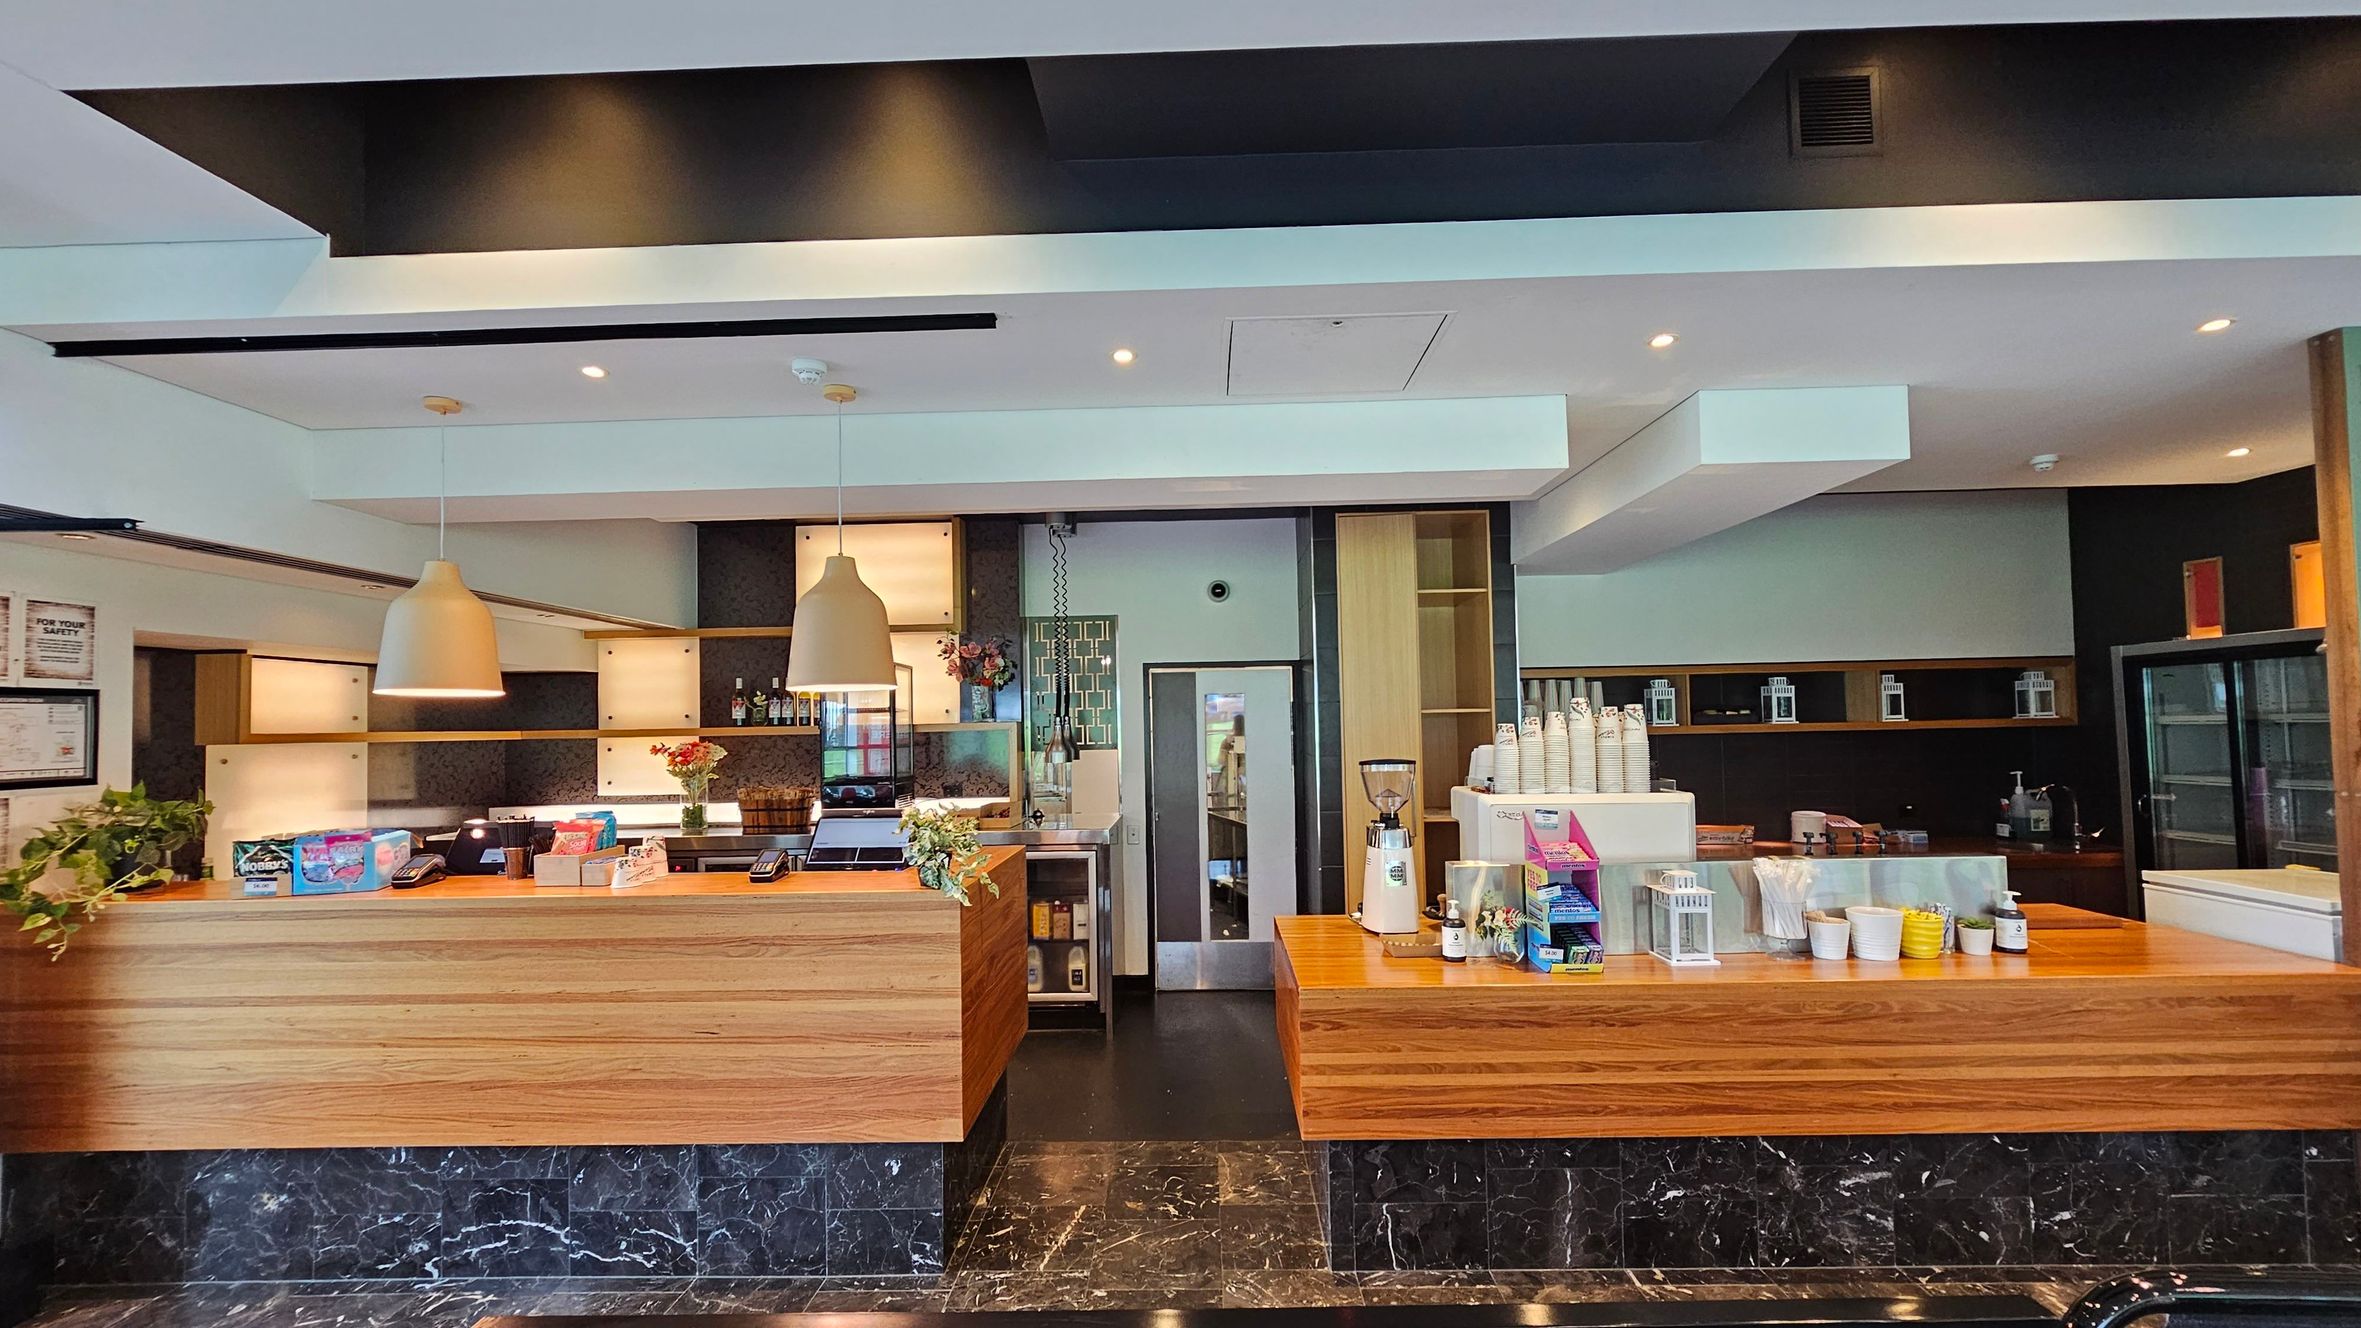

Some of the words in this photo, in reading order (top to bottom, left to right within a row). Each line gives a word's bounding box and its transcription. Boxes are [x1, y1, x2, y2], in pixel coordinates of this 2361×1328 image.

[36, 618, 56, 627] FOR
[58, 620, 87, 629] YOUR
[43, 627, 80, 636] SAFETY
[240, 860, 289, 873] NOBBY'S
